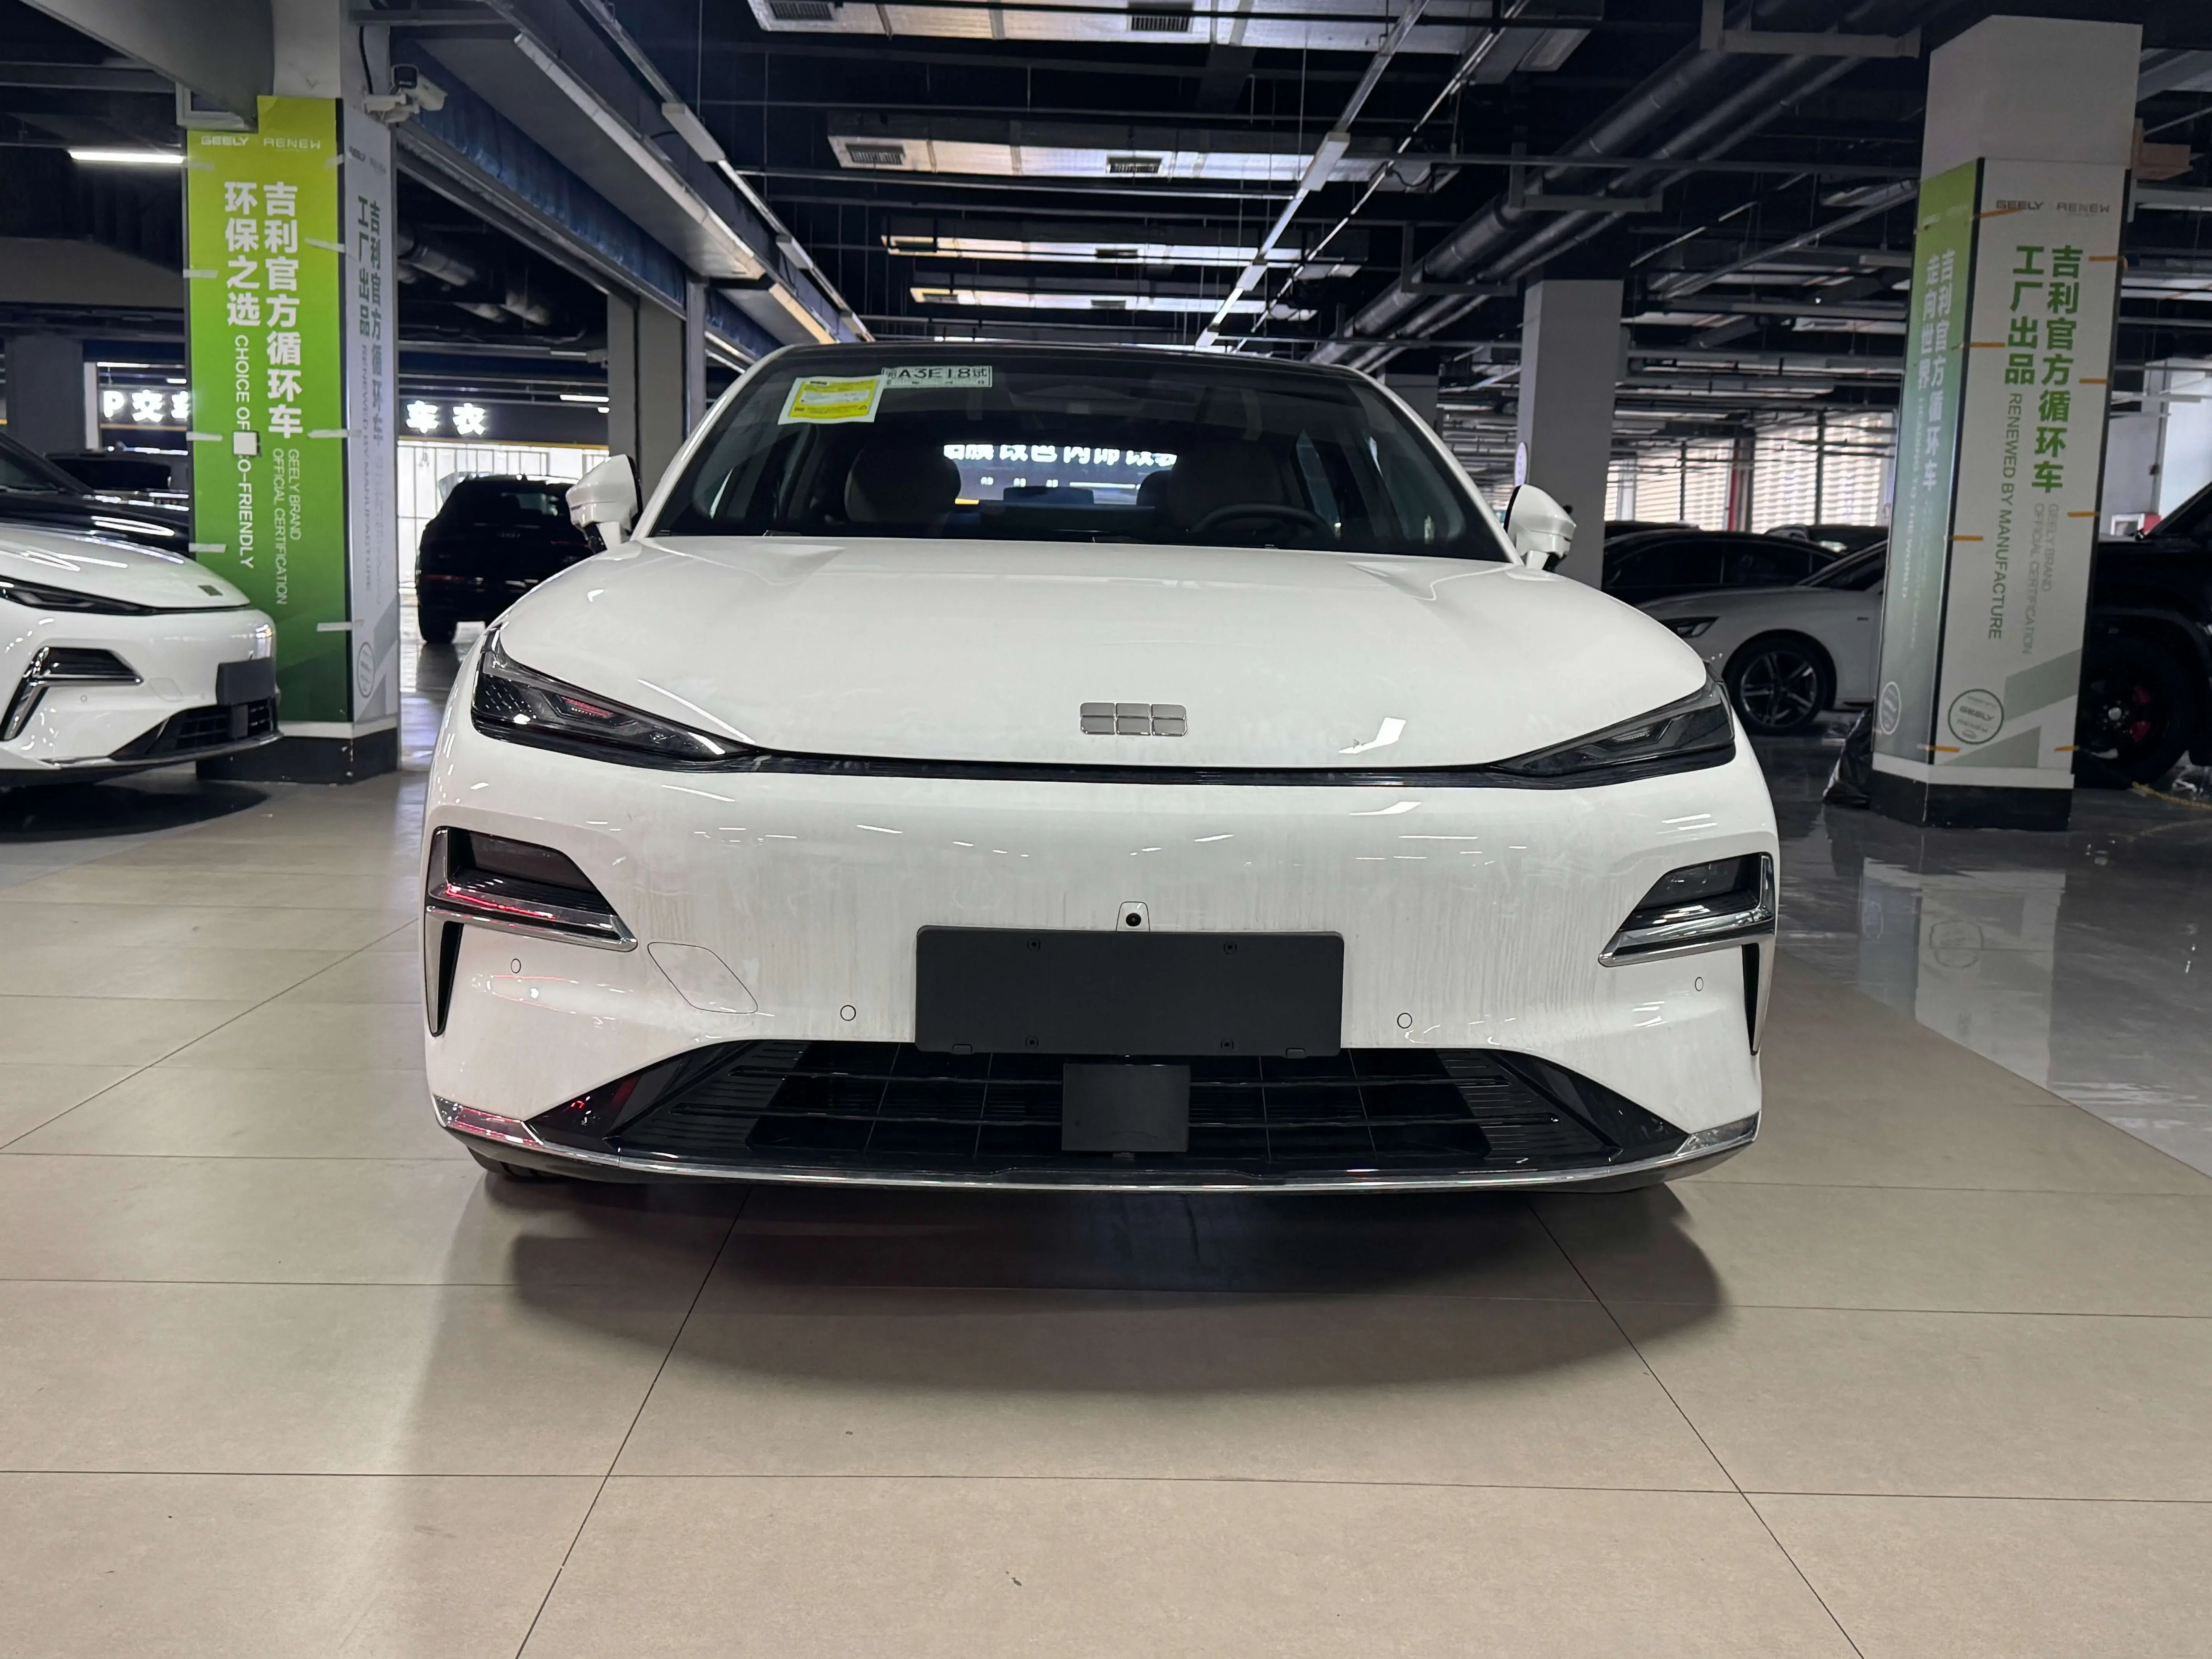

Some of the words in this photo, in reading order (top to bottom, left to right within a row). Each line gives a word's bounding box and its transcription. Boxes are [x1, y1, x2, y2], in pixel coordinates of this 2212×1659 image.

[201, 136, 249, 146] GEELY
[1996, 200, 2044, 210] GEELY
[224, 181, 261, 326] 环保之选
[358, 195, 370, 337] 工厂出品
[263, 181, 303, 438] 吉利官方循环车
[2004, 245, 2044, 385] 工厂出品
[235, 335, 249, 402] CHOICE
[2032, 245, 2083, 494] 吉利官方循环车
[236, 407, 250, 430] OF
[2003, 393, 2022, 478] RENEWED
[237, 455, 254, 568] O-FRIENDLY
[273, 448, 285, 505] OFFICIAL
[288, 449, 300, 493] GEELY
[2000, 483, 2014, 505] BY
[274, 508, 288, 605] CERTIFICATION
[289, 495, 301, 540] BRAND
[1988, 509, 2012, 640] MANUFACTURE
